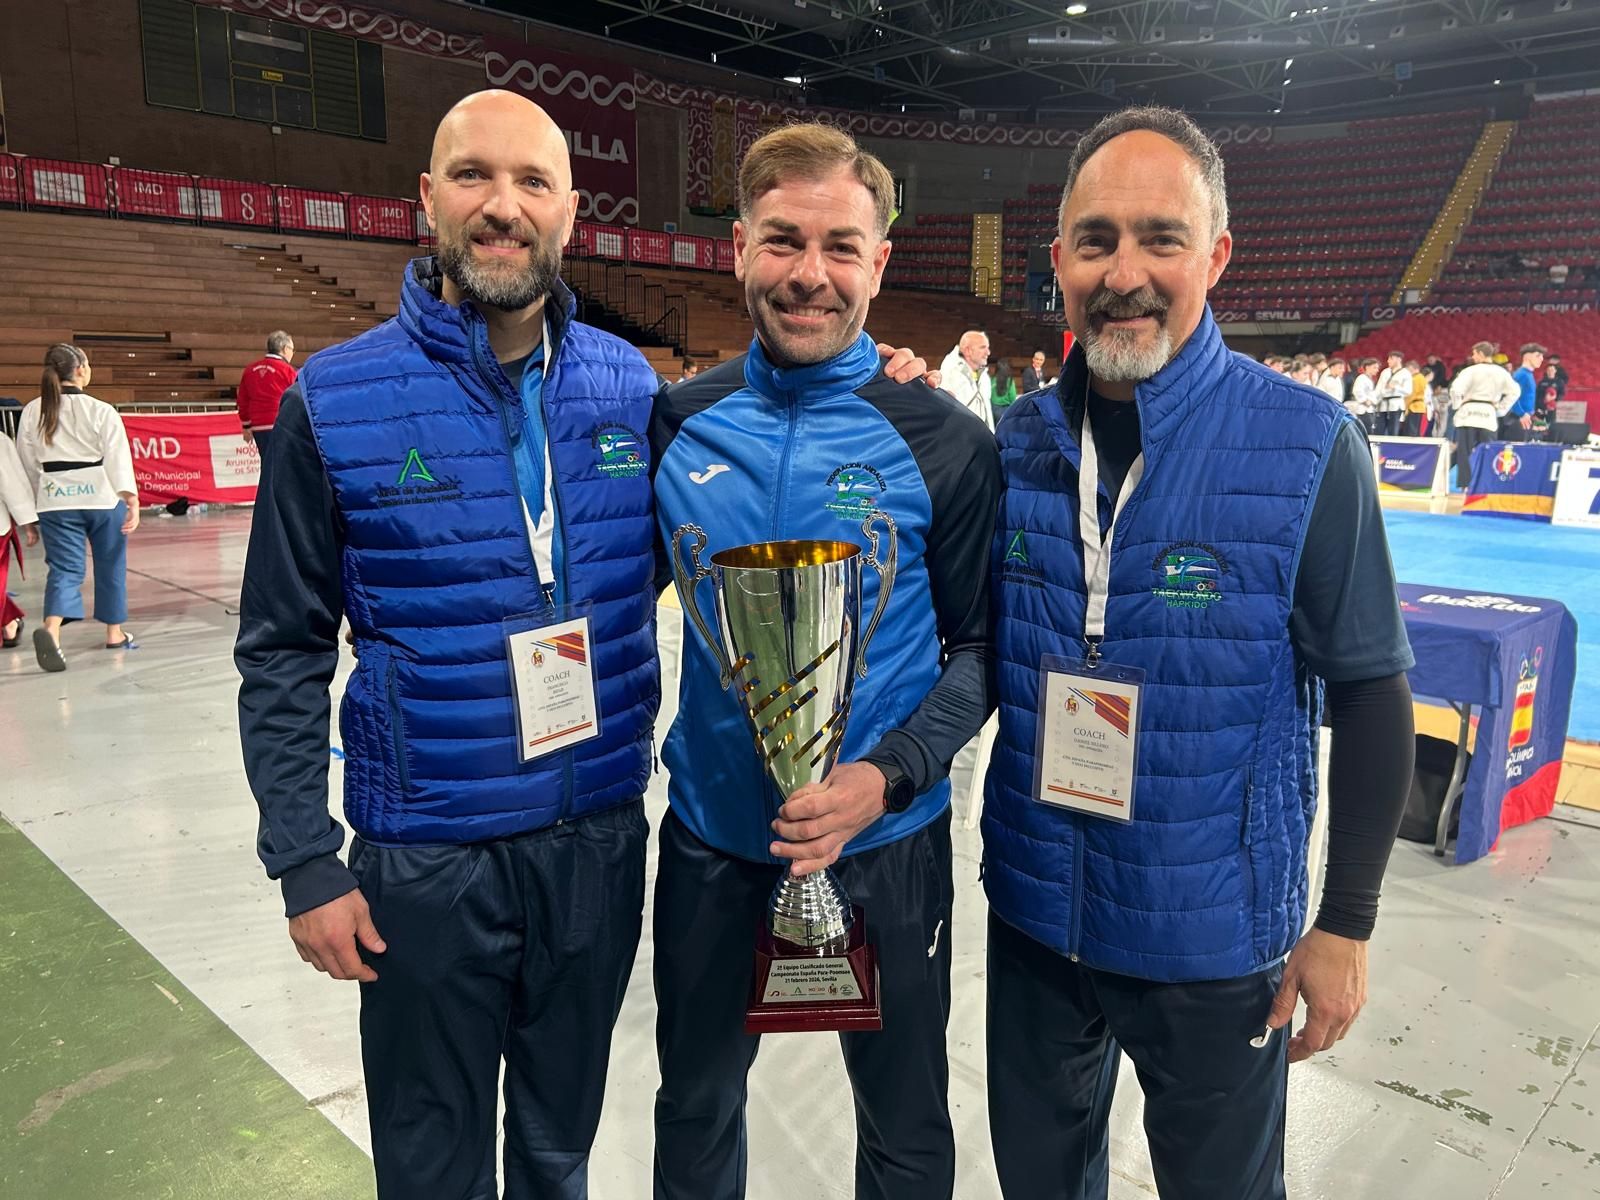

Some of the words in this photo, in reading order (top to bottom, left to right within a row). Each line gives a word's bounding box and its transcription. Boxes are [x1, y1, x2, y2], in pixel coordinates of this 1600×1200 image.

[134, 181, 163, 196] IMD
[381, 207, 404, 219] IMD
[1256, 311, 1300, 320] SEVILLA
[132, 437, 181, 459] MD
[155, 471, 201, 481] Municipal
[145, 482, 189, 492] Deportes
[1167, 600, 1207, 609] HAPKIDO
[544, 670, 570, 684] COACH
[1073, 728, 1105, 740] COACH
